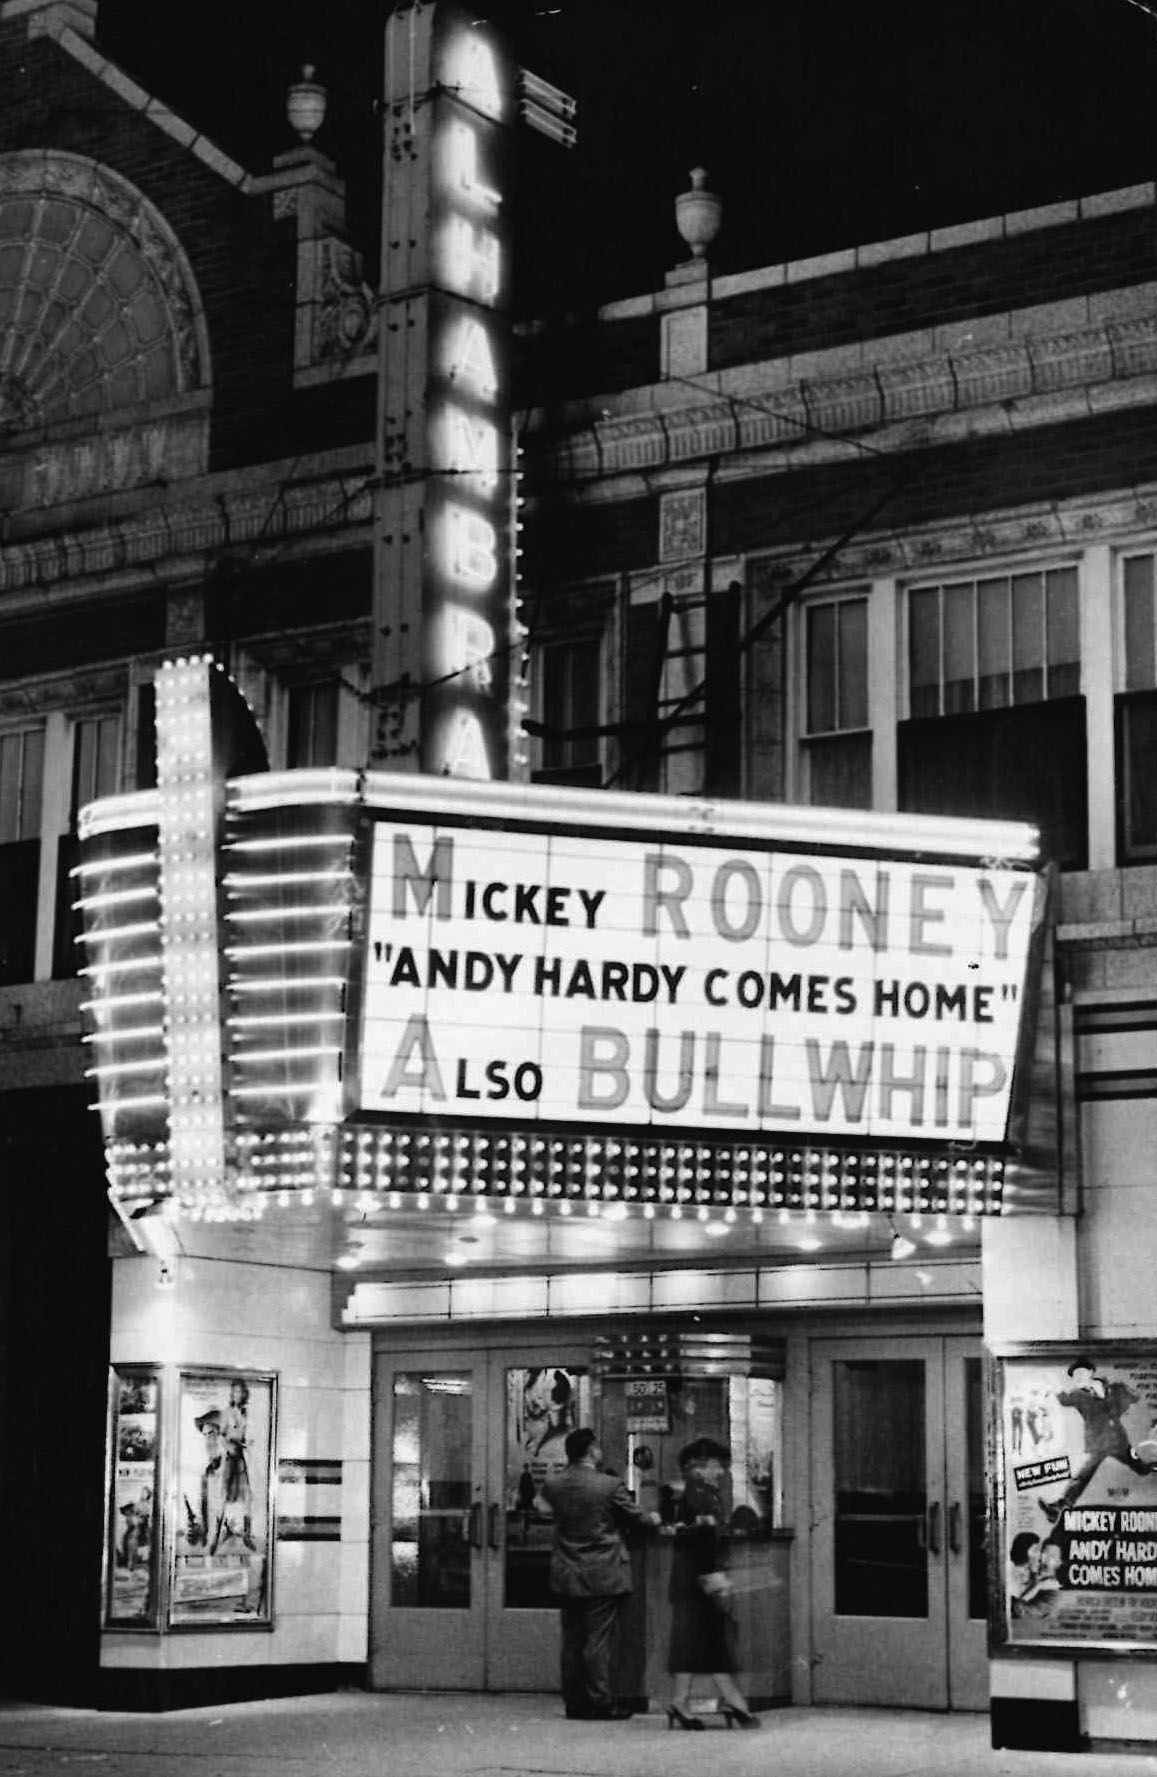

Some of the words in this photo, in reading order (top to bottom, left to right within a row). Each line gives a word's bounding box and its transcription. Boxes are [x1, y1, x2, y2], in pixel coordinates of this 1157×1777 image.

[436, 27, 503, 781] ALHAMBRA
[392, 833, 606, 929] MICKEY
[641, 852, 1029, 960] ROONEY
[374, 941, 523, 993] "ANDY
[533, 956, 687, 1004] HARDY
[703, 967, 858, 1015] COMES
[873, 978, 1018, 1023] HOME"
[380, 1012, 543, 1102] ALSO
[576, 1025, 1008, 1129] BULLWHIP
[1064, 1510, 1117, 1532] MICKEY
[1068, 1539, 1113, 1561] ANDY
[1115, 1540, 1157, 1562] HARD
[1068, 1562, 1121, 1587] COMES
